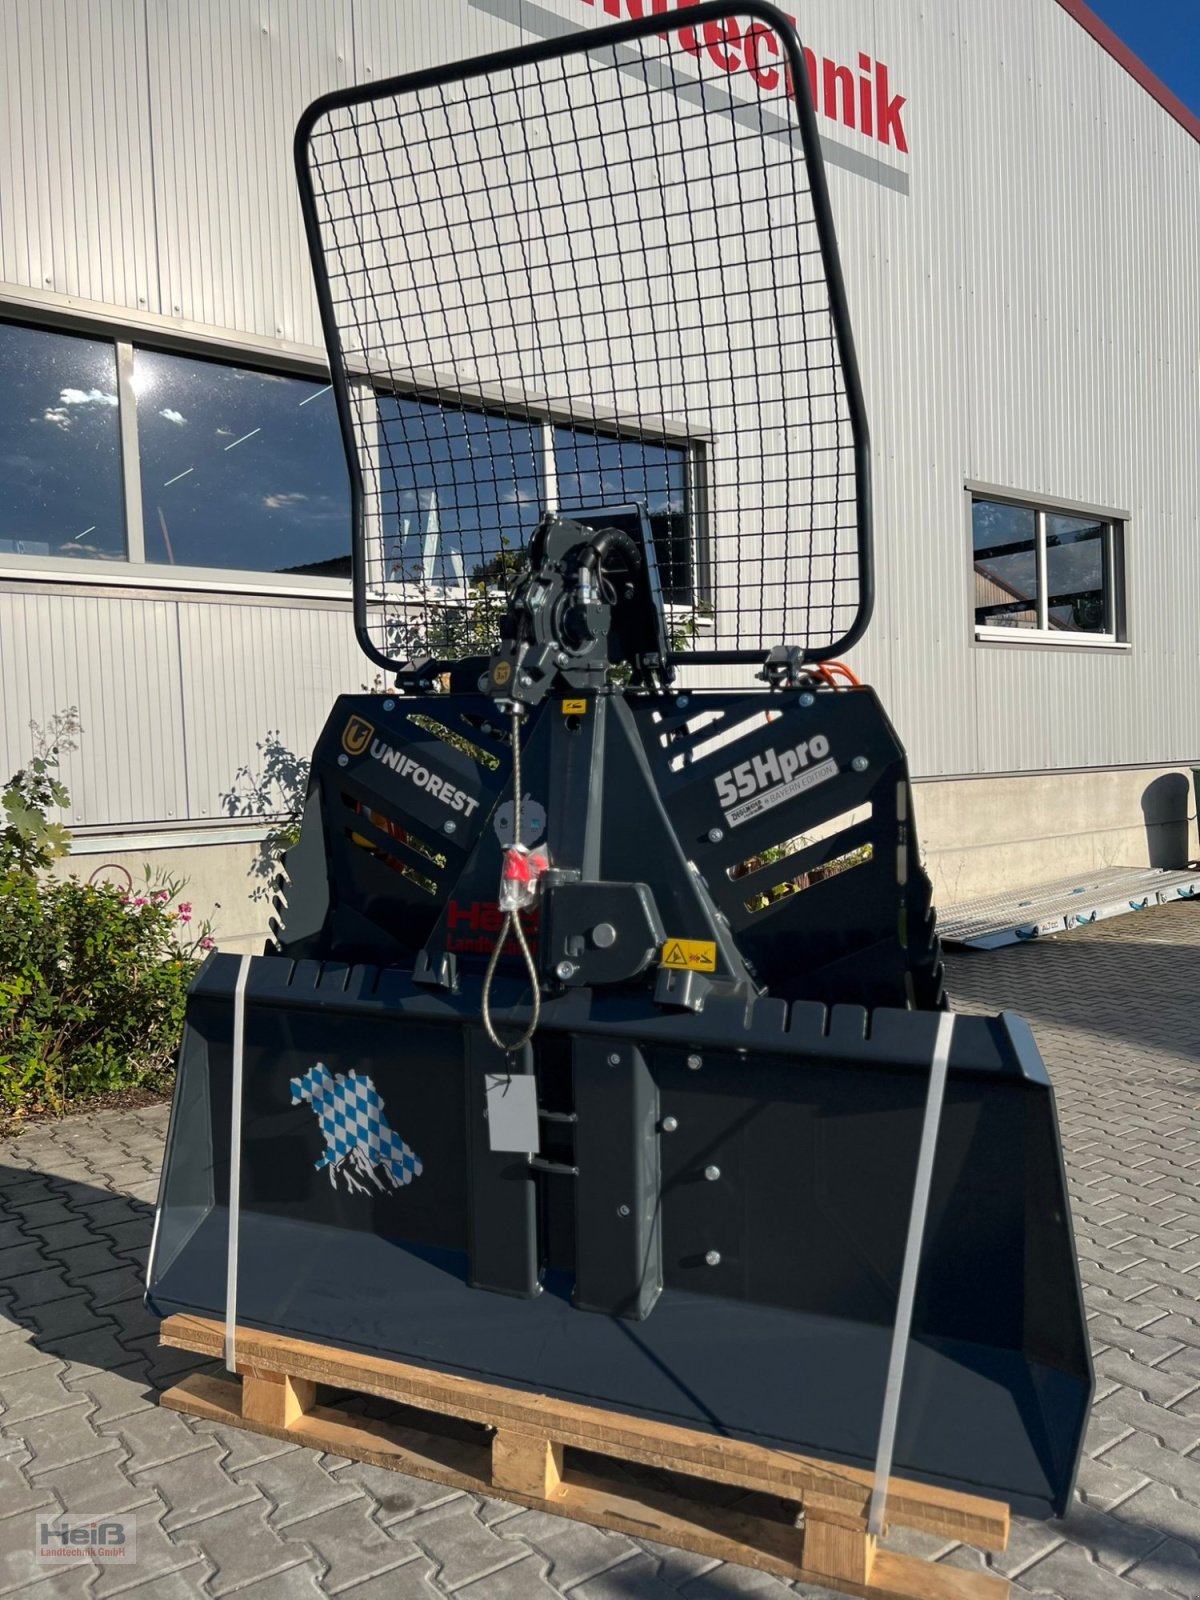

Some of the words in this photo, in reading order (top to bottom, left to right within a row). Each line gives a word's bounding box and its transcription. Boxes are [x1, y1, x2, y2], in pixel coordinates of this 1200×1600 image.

[370, 739, 478, 816] UNIFOREST
[715, 735, 829, 806] 55Hpro
[769, 781, 801, 802] BAYERN
[801, 766, 833, 785] EDITION
